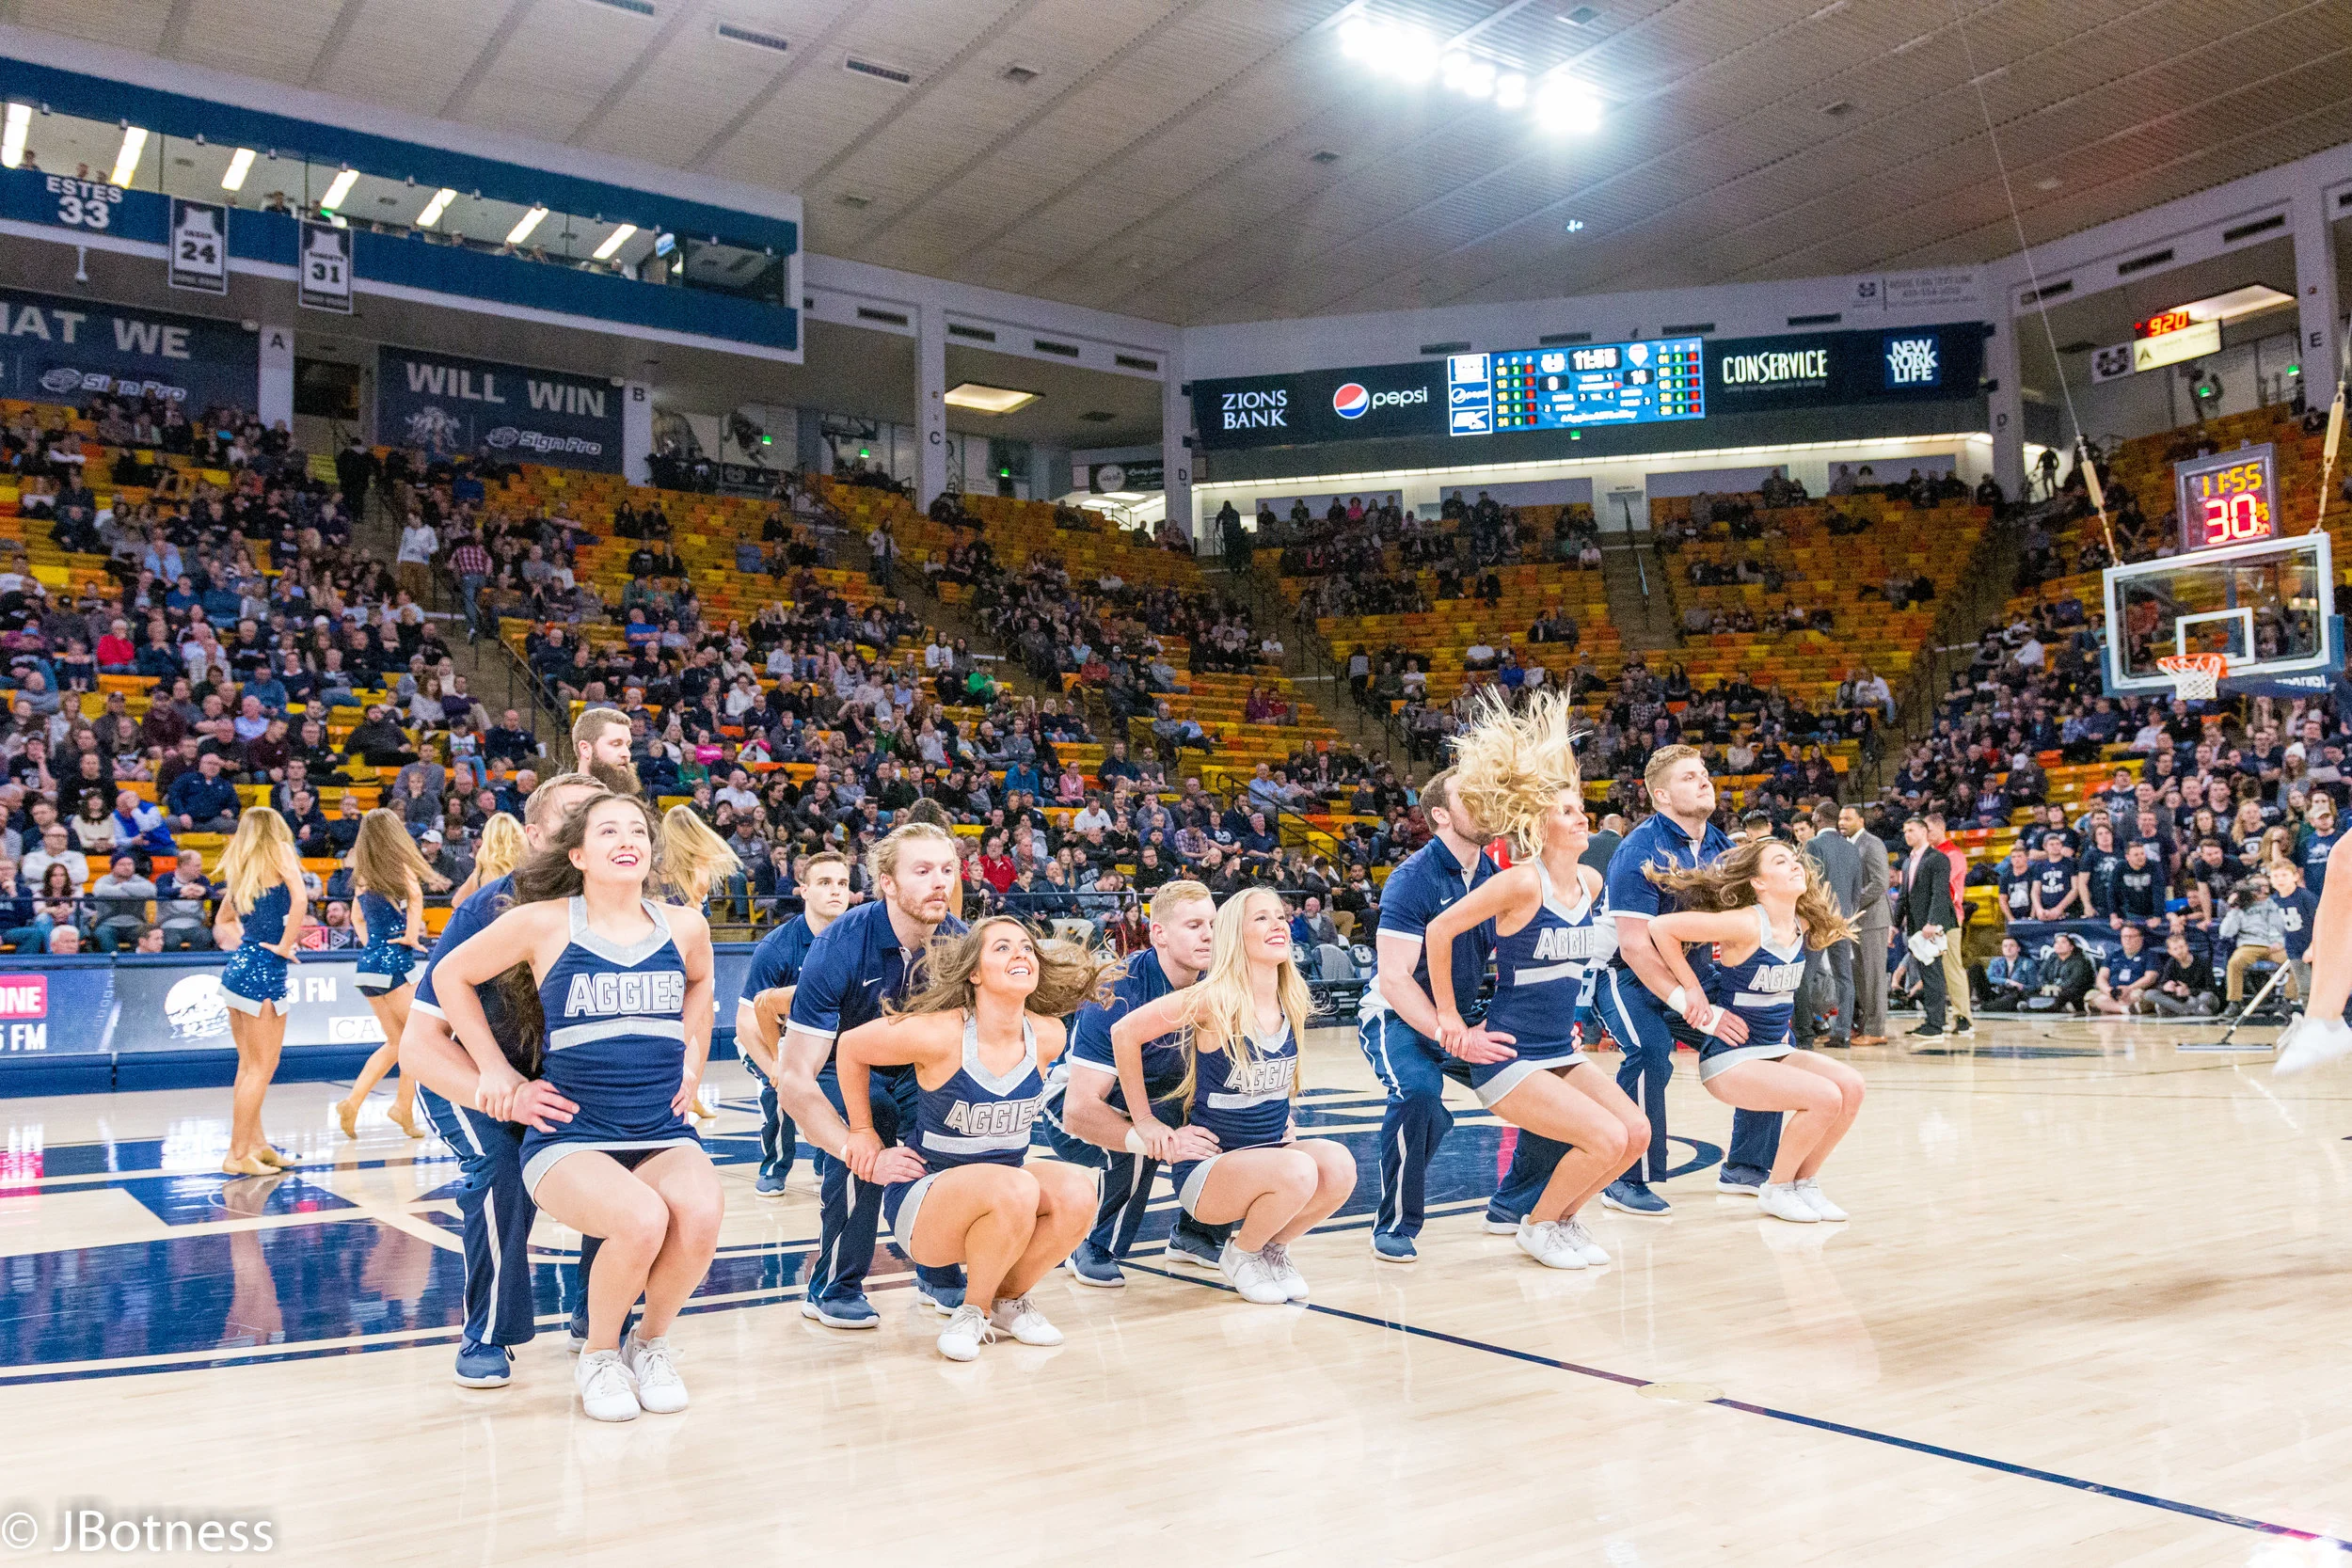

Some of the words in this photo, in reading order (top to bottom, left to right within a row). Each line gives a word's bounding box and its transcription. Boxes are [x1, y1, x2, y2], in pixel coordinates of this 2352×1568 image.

[46, 172, 123, 204] ESTES
[57, 196, 110, 229] 33
[181, 240, 215, 264] 24
[311, 261, 341, 284] 31
[112, 317, 191, 359] WE
[270, 334, 284, 350] A
[1892, 339, 1932, 356] NEW
[2310, 331, 2323, 348] E
[1723, 349, 1828, 384] CONSERVICE
[1885, 351, 1938, 369] YORK
[1894, 365, 1933, 383] LIFE
[405, 361, 505, 404] WILL
[527, 379, 608, 418] WIN
[632, 387, 645, 403] B
[1222, 389, 1288, 410] ZIONS
[1372, 386, 1428, 410] pepsi
[1223, 408, 1288, 430] BANK
[930, 431, 941, 446] C
[1178, 467, 1187, 482] D
[2201, 464, 2262, 498] 11:55
[2204, 493, 2257, 544] 30
[0, 987, 41, 1014] NE
[306, 977, 338, 1003] FM
[564, 970, 686, 1018] AGGIES
[10, 1023, 47, 1051] FM
